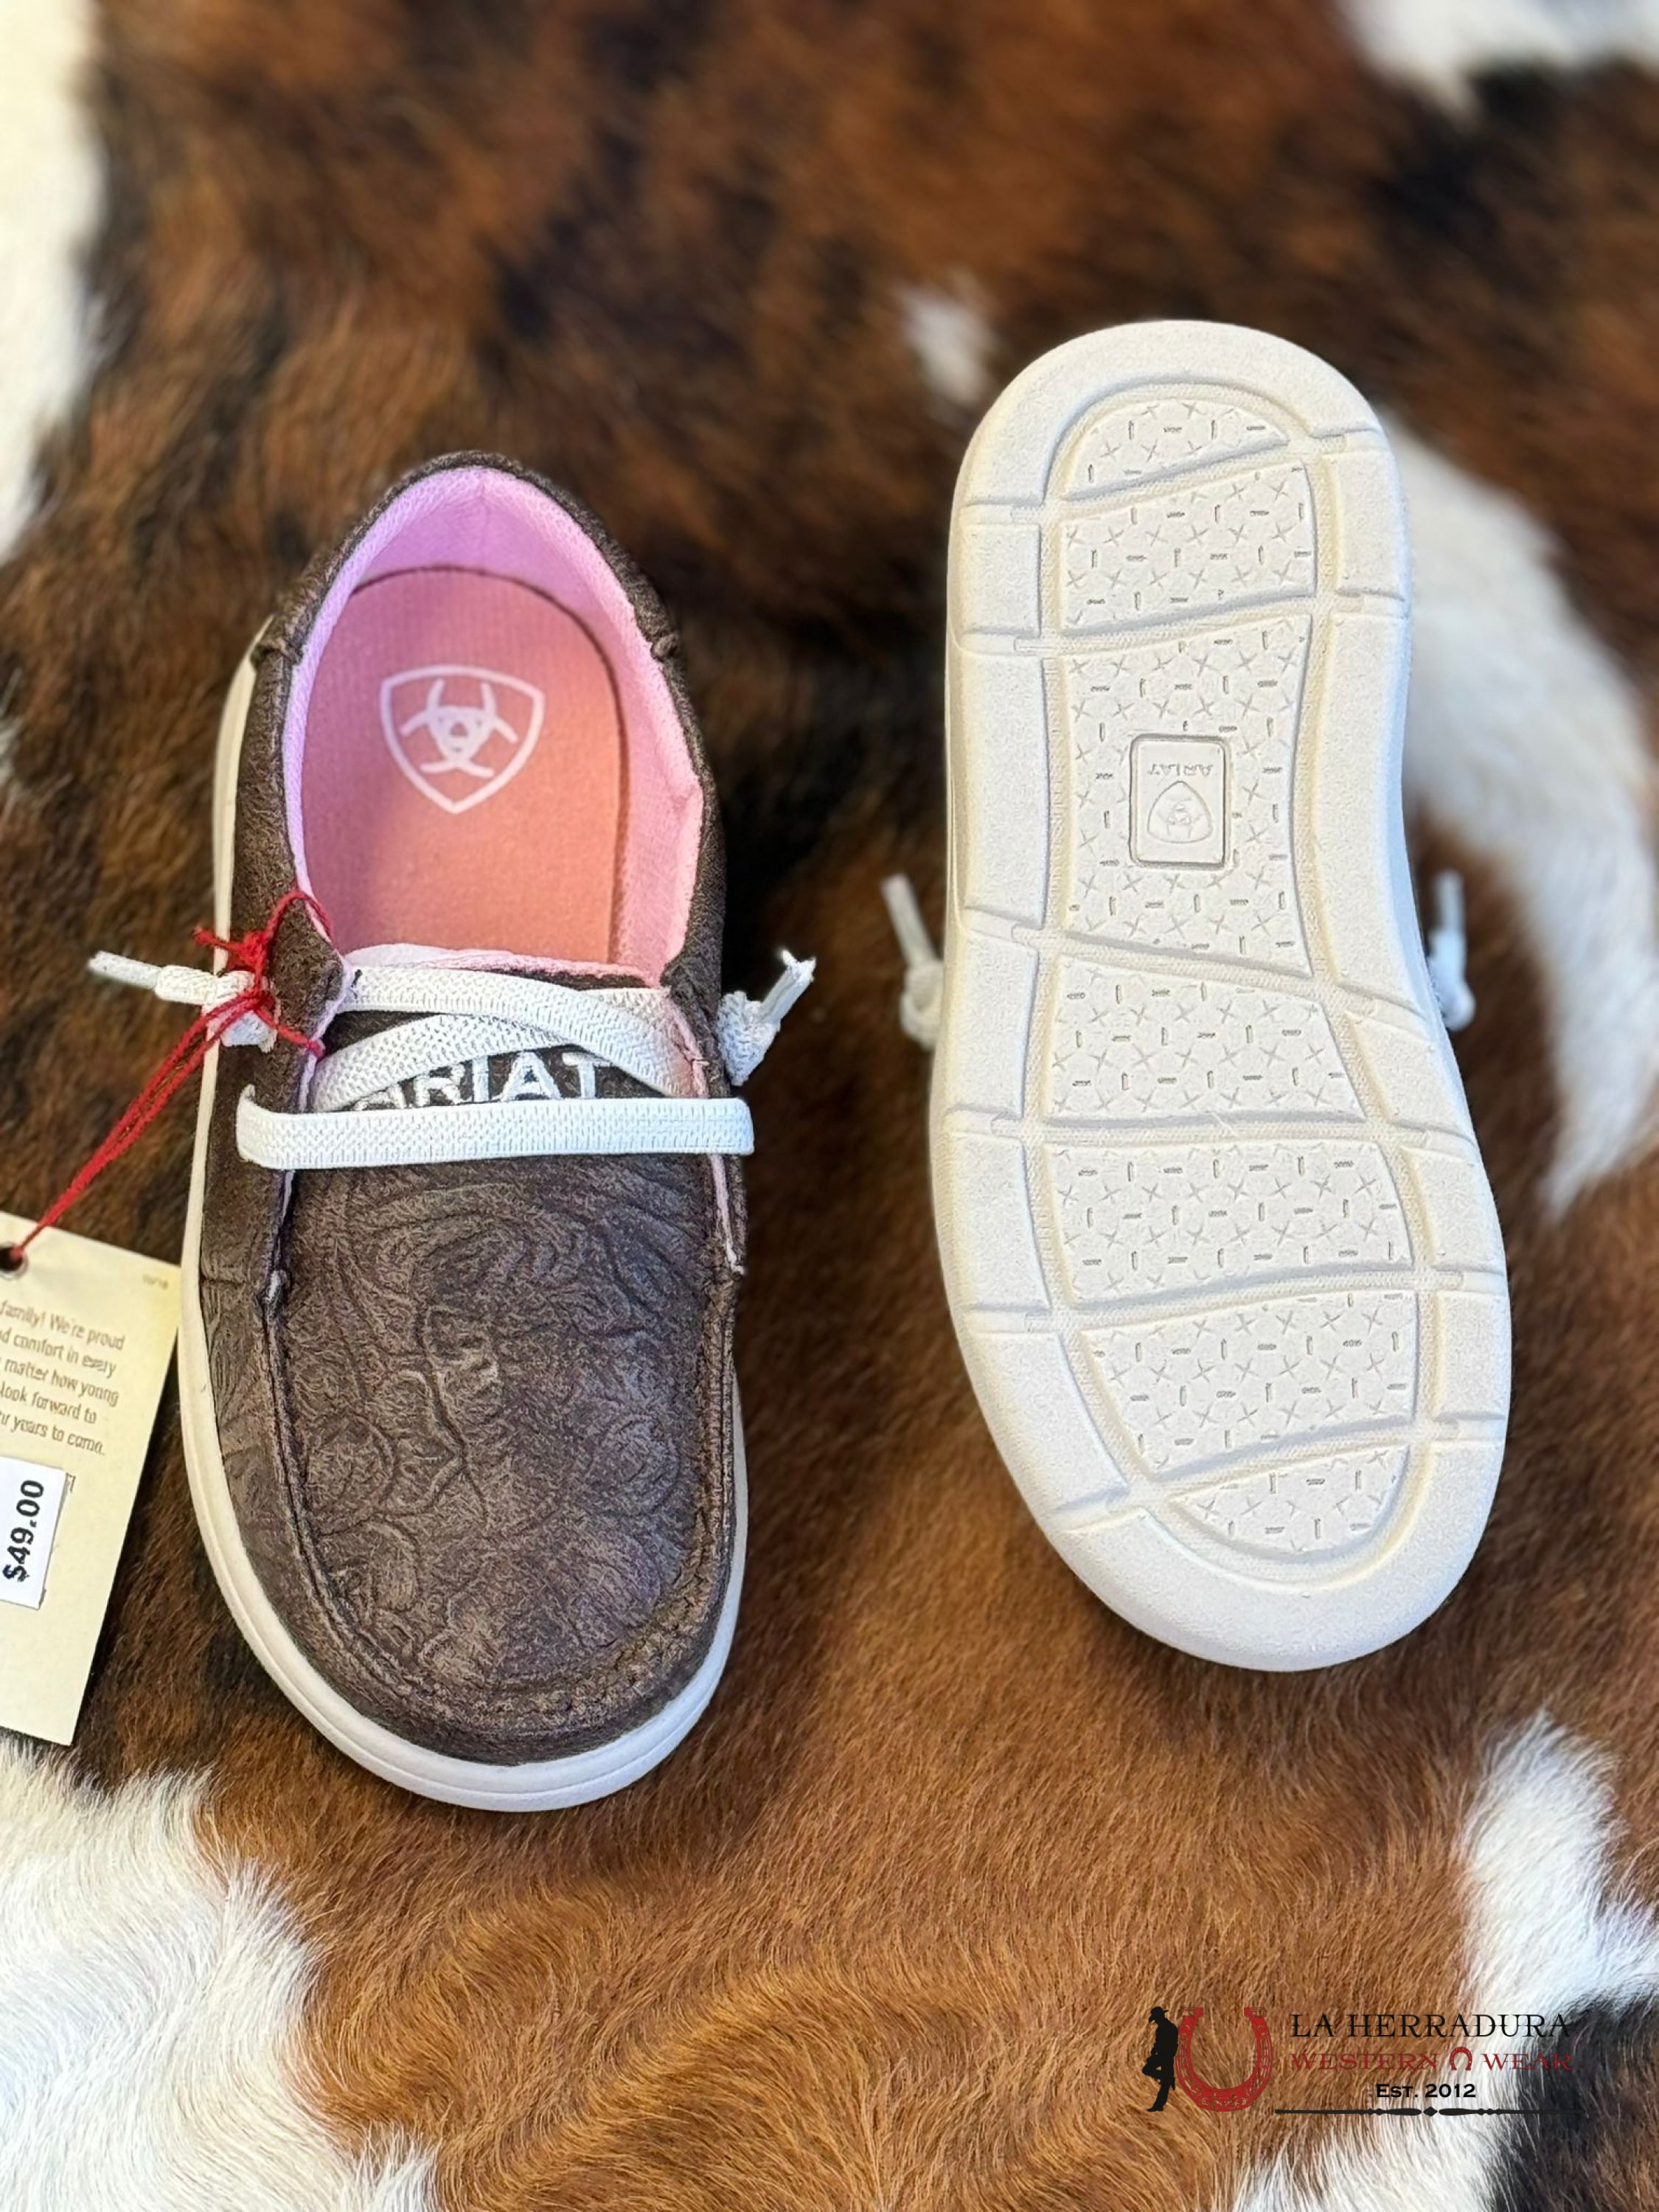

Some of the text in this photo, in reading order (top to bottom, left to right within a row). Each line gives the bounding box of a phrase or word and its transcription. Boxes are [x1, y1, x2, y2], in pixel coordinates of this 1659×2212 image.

[1147, 763, 1214, 777] ARIAT
[13, 1334, 65, 1361] comfort
[66, 1346, 79, 1364] in
[86, 1329, 125, 1351] proud
[4, 1358, 119, 1408] matter how young
[0, 1380, 27, 1402] look
[32, 1391, 82, 1420] forward
[83, 1408, 97, 1425] to
[10, 1416, 49, 1438] years
[52, 1425, 66, 1442] to
[2, 1480, 45, 1582] $49.00
